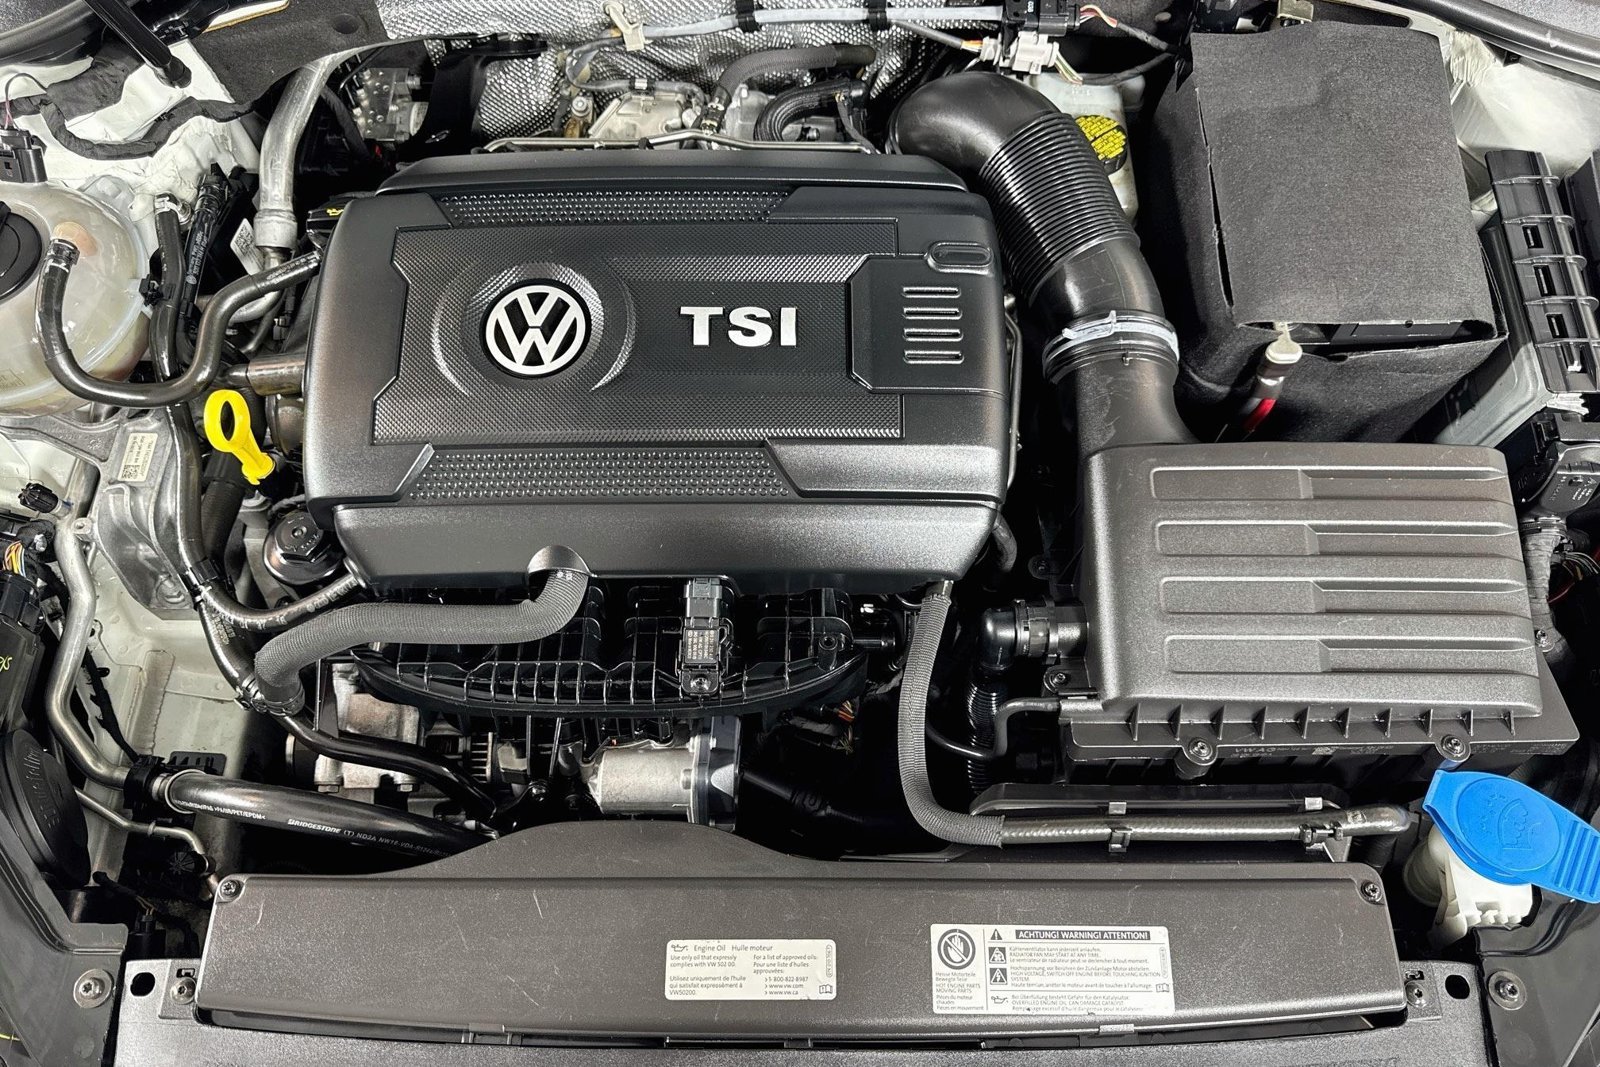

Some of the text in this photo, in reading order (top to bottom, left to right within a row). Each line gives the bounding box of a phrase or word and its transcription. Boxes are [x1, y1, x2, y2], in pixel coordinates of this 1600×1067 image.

[486, 285, 586, 375] VW
[680, 306, 797, 347] TSI
[287, 818, 342, 834] BRIDGESTONE
[1018, 931, 1148, 939] ACHTUNG! WARNING! ATTENTION!
[694, 945, 773, 953] Engine Oil Huile moteur
